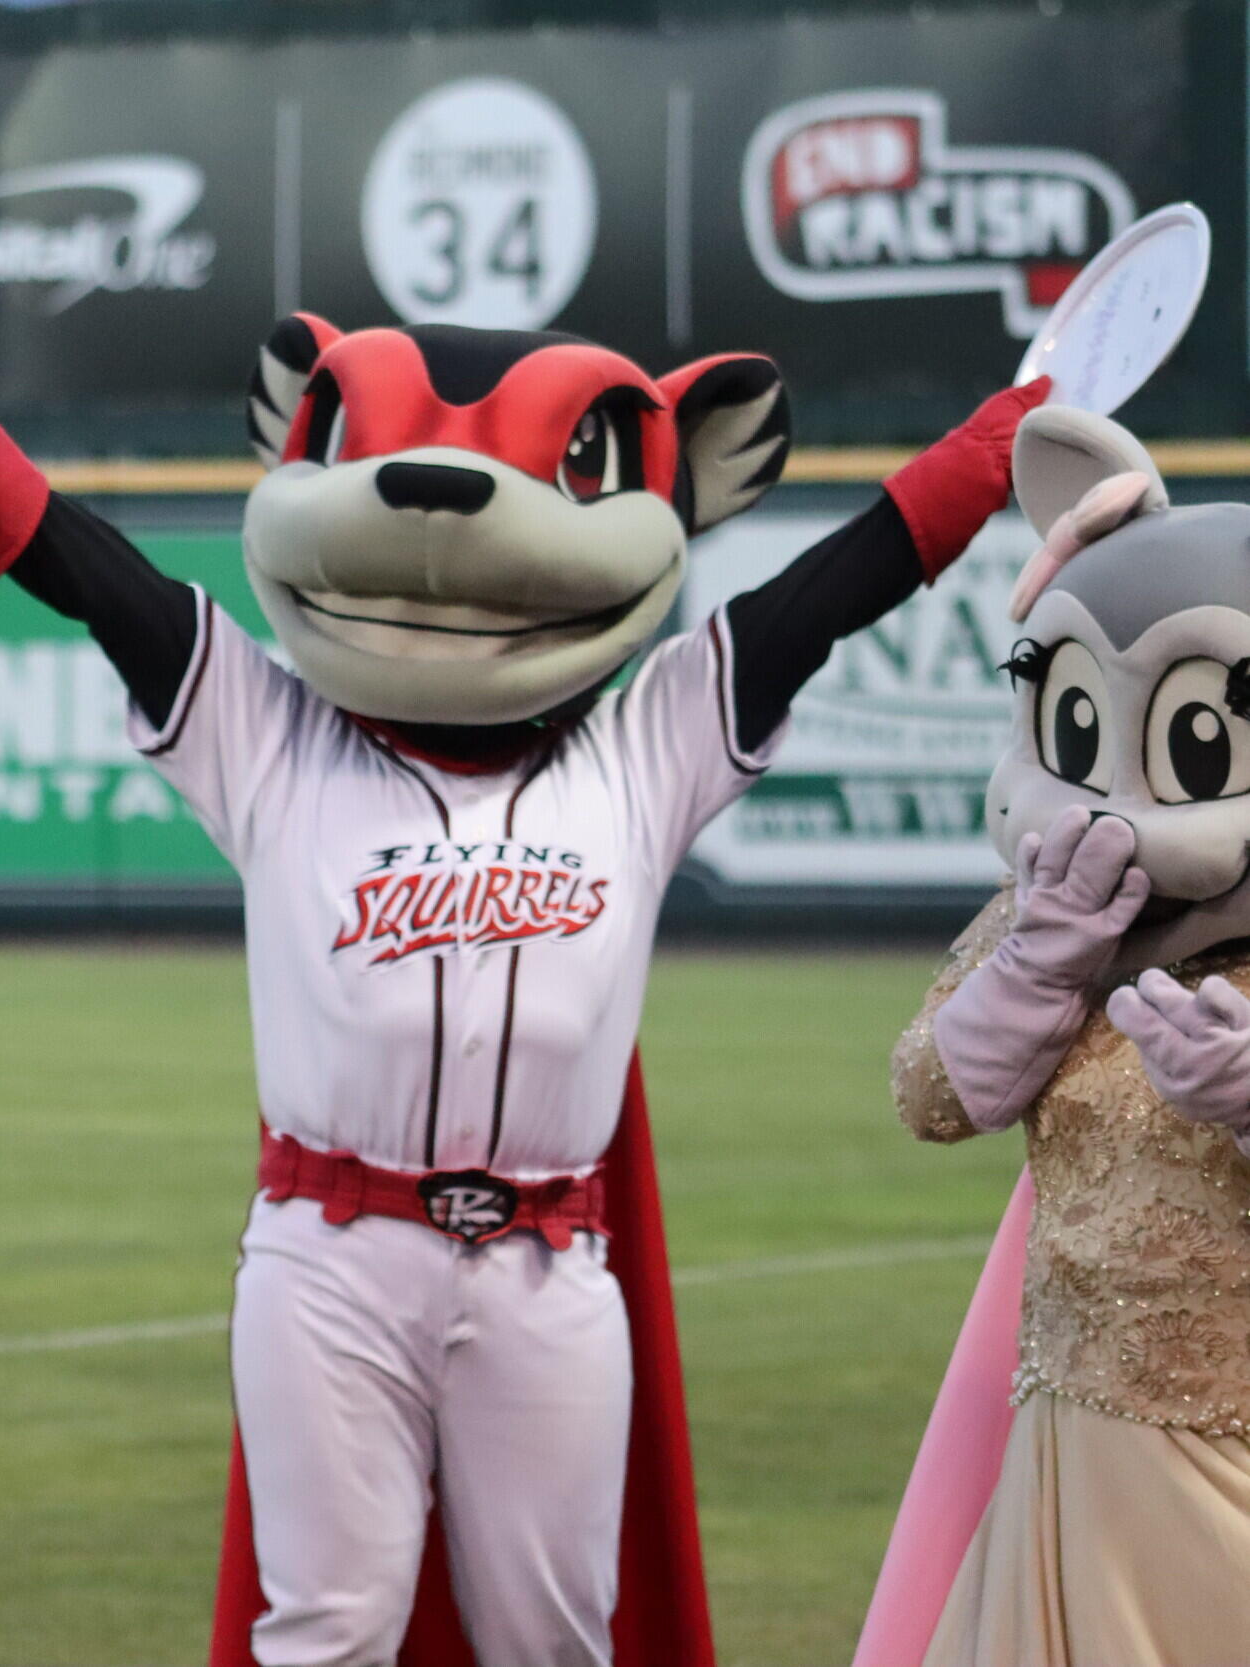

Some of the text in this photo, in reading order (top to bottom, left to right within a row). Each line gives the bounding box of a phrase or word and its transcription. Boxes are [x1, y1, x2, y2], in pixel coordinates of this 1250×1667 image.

[781, 122, 910, 202] END
[407, 196, 540, 308] 34
[799, 176, 1089, 271] RACISM
[359, 844, 583, 877] FLYING
[331, 867, 611, 966] SQUIRRELS
